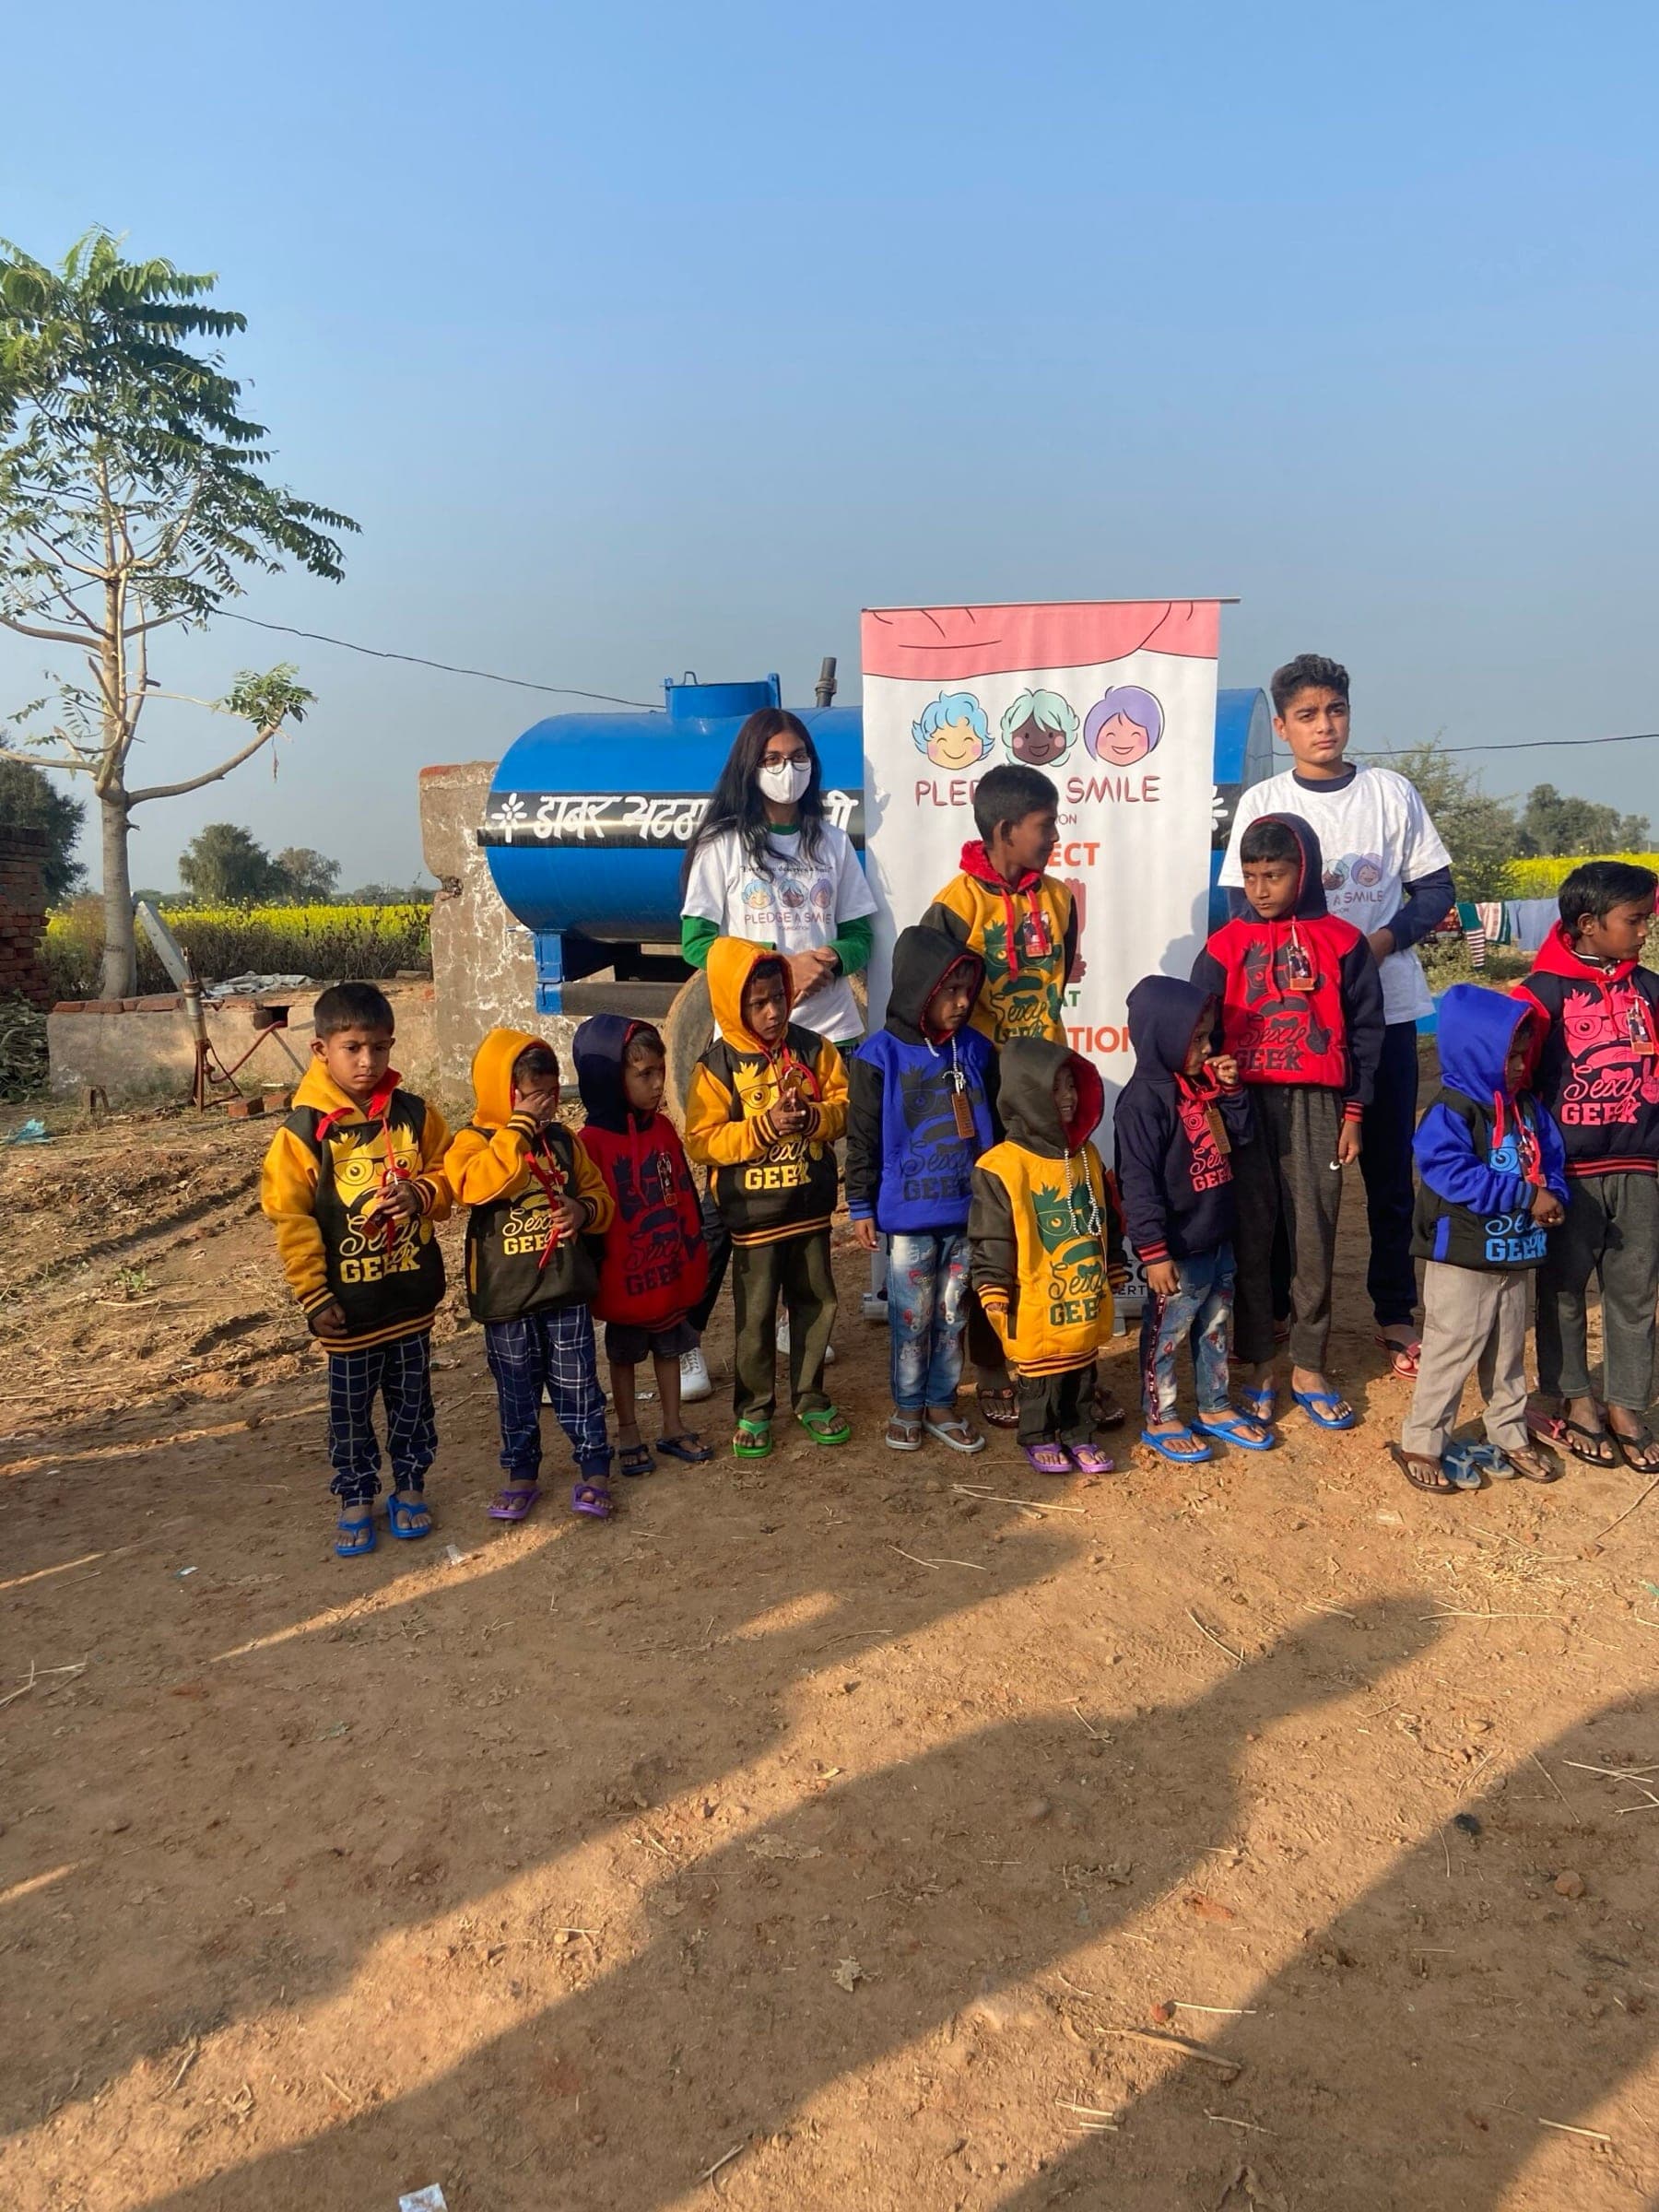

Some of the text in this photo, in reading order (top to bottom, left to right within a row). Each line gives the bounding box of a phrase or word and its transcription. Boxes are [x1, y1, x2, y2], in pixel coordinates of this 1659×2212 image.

[1065, 775, 1160, 804] SMILE
[534, 795, 622, 841] डाबर
[1345, 890, 1383, 904] SMILE
[745, 912, 792, 924] PLEDGE
[1237, 1014, 1307, 1058] Sexy
[1233, 1047, 1303, 1072] GEEK
[1564, 1062, 1641, 1113] Sexy
[1561, 1101, 1641, 1125] GEEK
[745, 1161, 811, 1190] GEEK
[503, 1232, 565, 1254] GEE
[1486, 1229, 1547, 1261] GEEK
